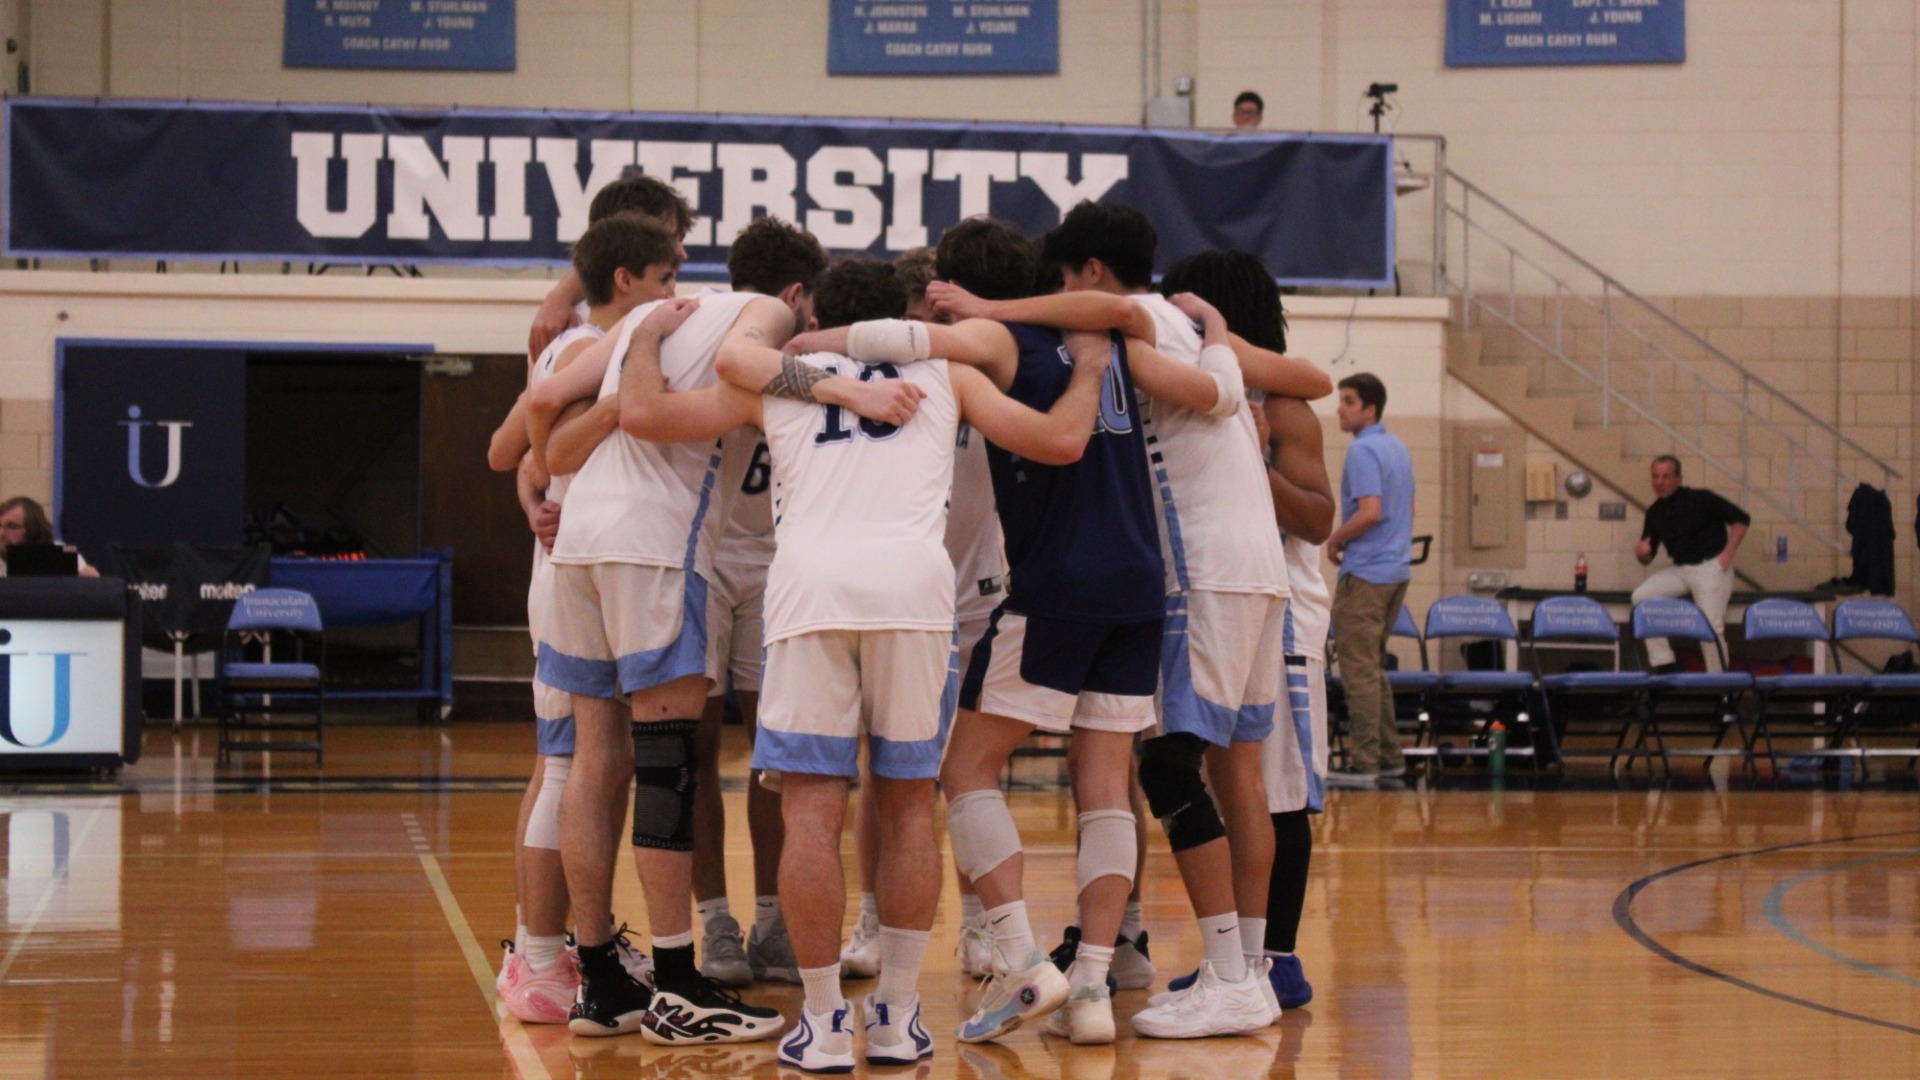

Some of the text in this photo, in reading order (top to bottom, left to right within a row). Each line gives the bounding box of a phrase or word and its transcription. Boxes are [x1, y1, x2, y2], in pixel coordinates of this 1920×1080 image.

[436, 16, 475, 30] YOUNG
[1479, 13, 1494, 26] M.
[1603, 11, 1643, 24] YOUNG
[979, 21, 1018, 35] YOUNG
[342, 37, 450, 50] COACH CATHY RUSH
[1505, 32, 1617, 48] COACH CATHY RUSH
[885, 43, 993, 57] COACH CATHY RUSH
[291, 131, 1129, 251] UNIVERSITY
[247, 607, 304, 619] University
[1442, 614, 1497, 628] University
[1547, 614, 1600, 628] University
[1646, 616, 1697, 630] University
[1758, 616, 1812, 630] University
[1848, 616, 1900, 630] University
